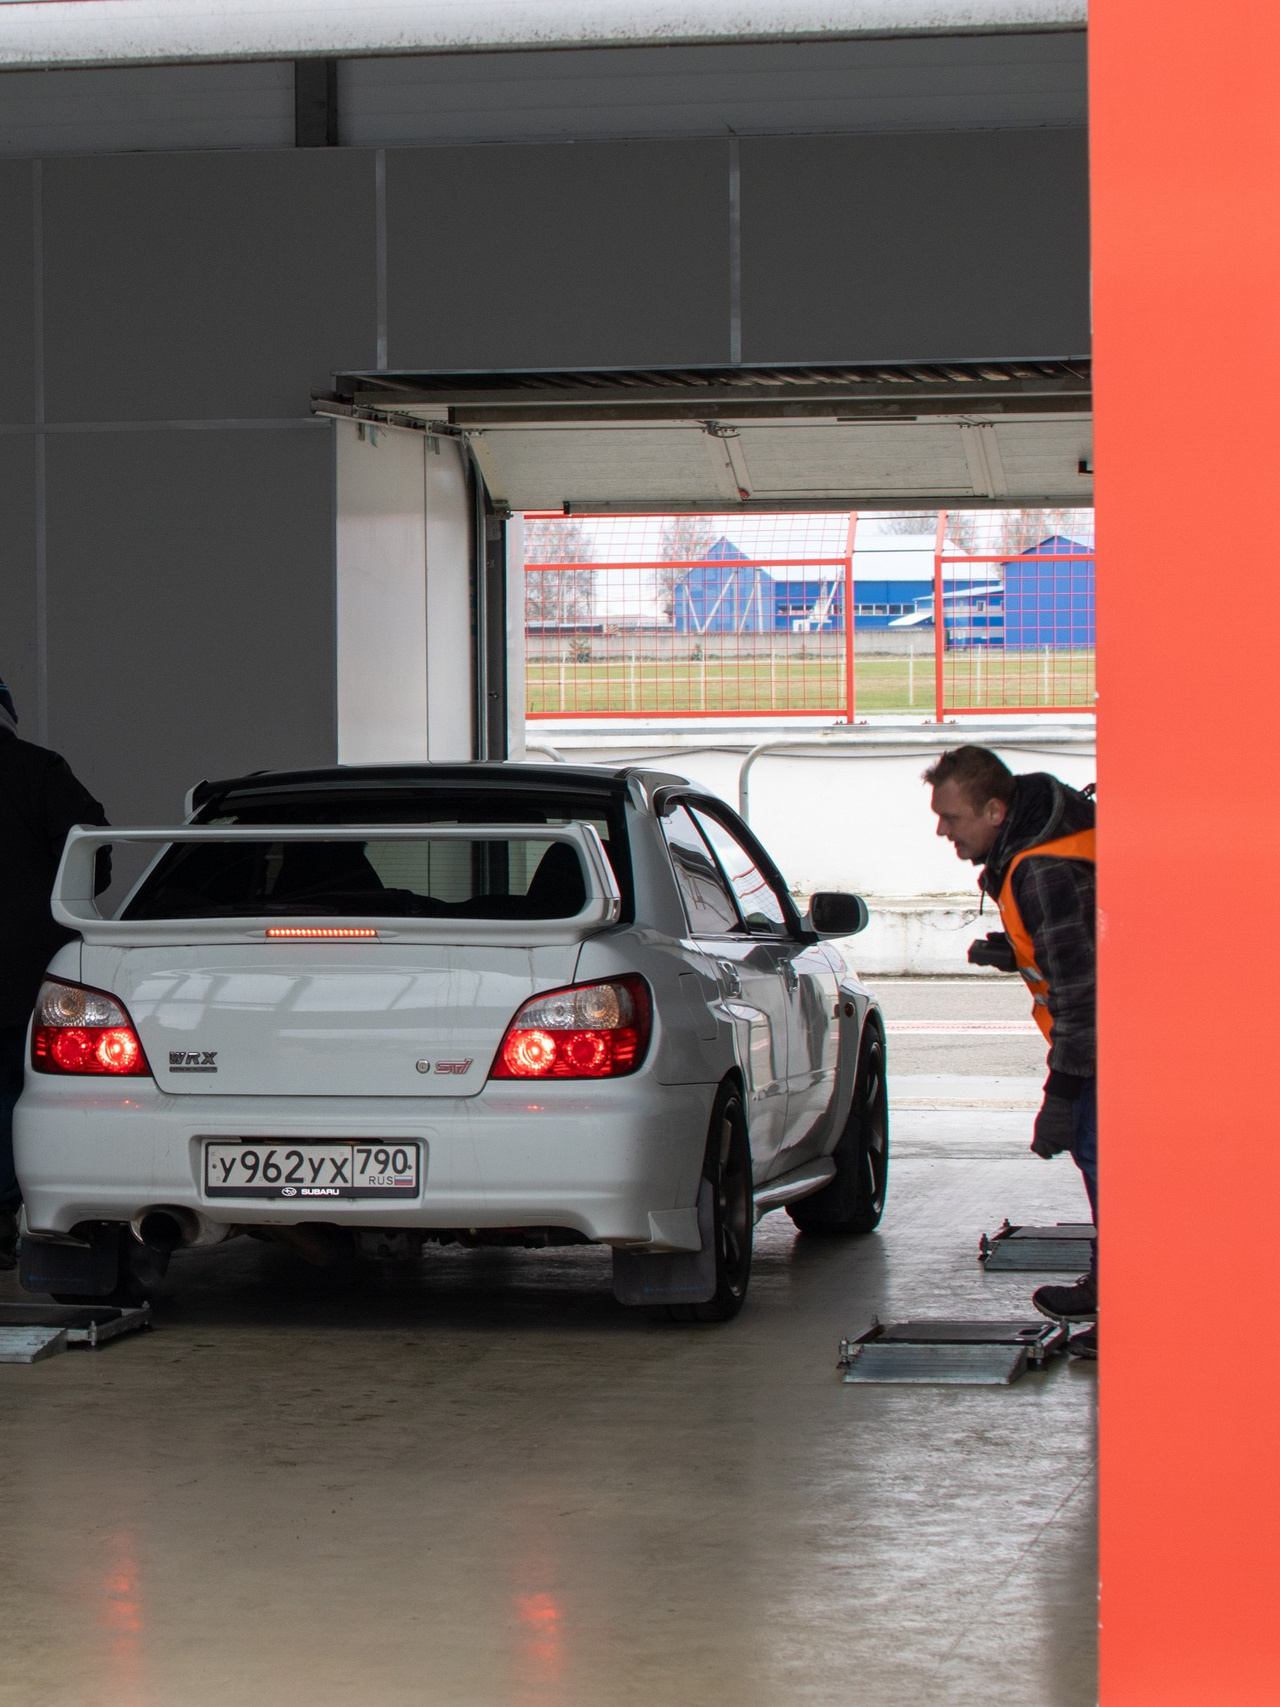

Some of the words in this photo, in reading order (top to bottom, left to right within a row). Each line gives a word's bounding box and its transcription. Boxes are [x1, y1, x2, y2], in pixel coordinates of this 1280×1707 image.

[169, 1051, 218, 1065] WRX
[356, 1149, 408, 1174] 790
[369, 1176, 393, 1185] RUS
[301, 1188, 340, 1196] SUBARU
